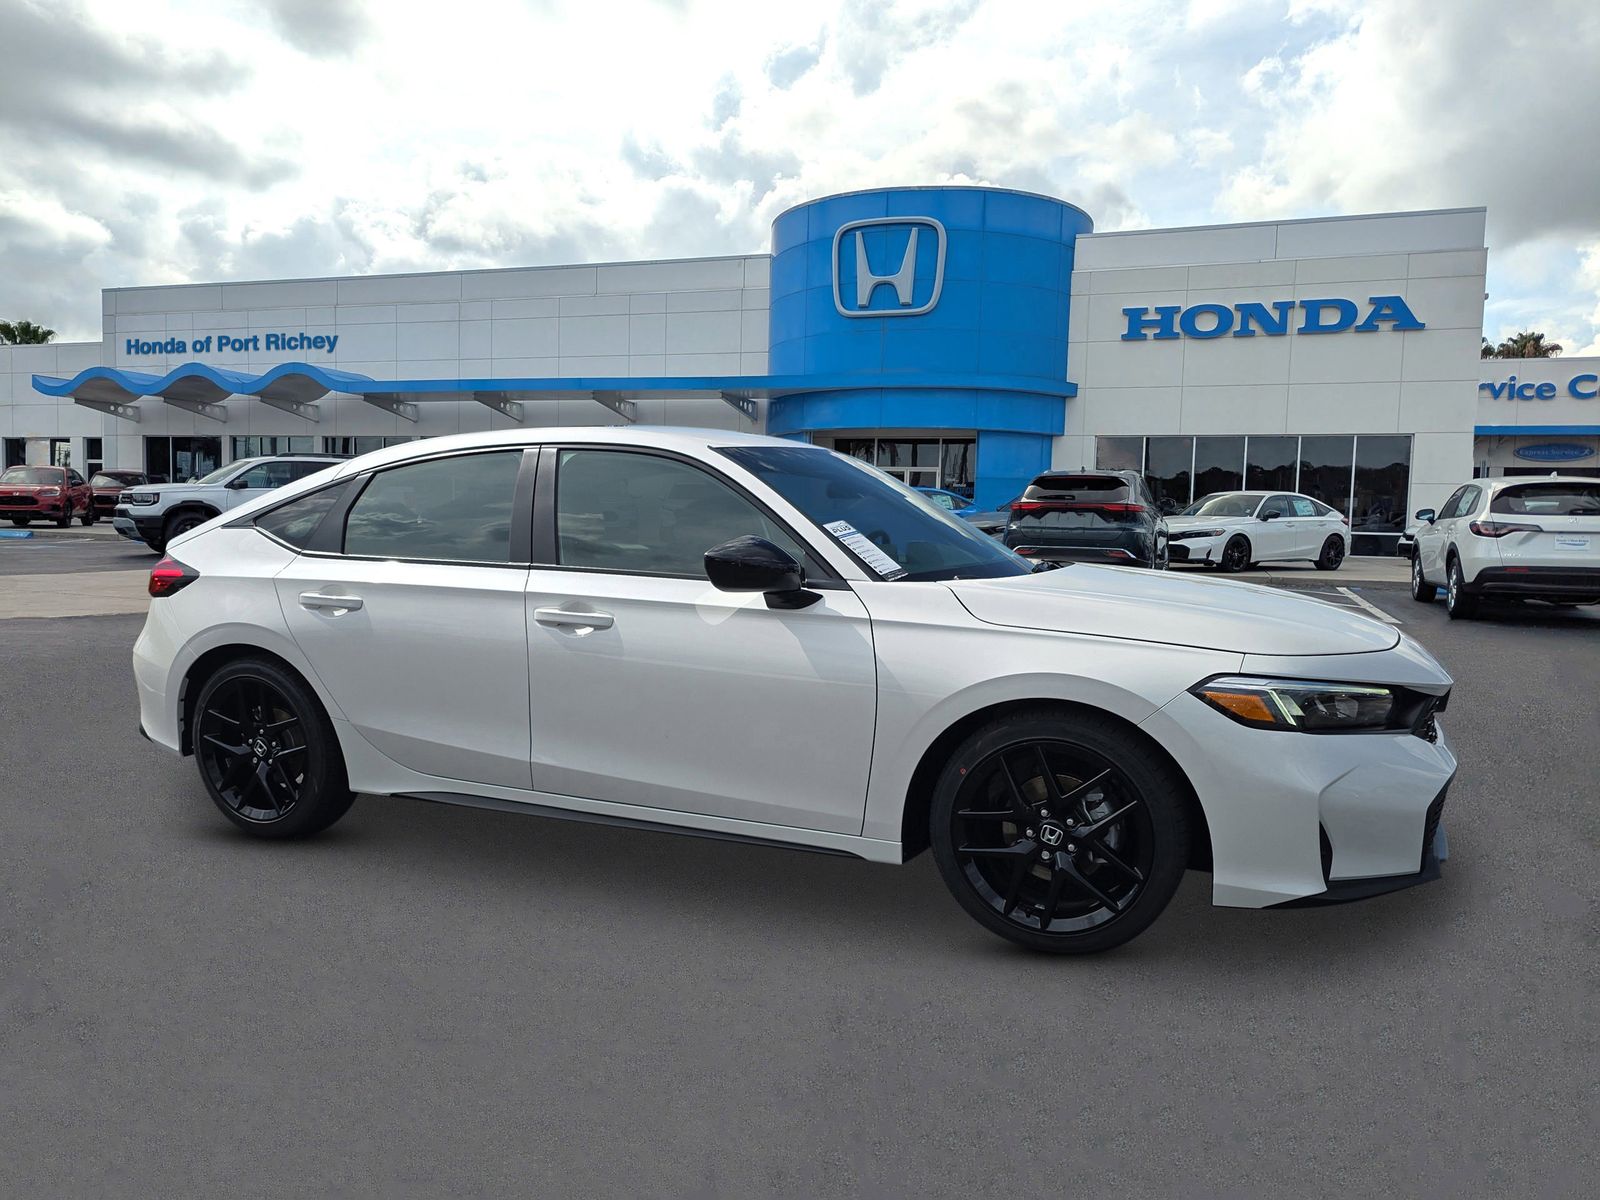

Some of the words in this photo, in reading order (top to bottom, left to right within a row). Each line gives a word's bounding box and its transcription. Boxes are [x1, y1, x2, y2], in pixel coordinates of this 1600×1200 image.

[1120, 295, 1426, 341] HONDA
[126, 337, 187, 355] Honda
[191, 335, 212, 353] of
[217, 334, 259, 352] Port
[265, 332, 338, 353] Richey
[1567, 373, 1600, 401] C
